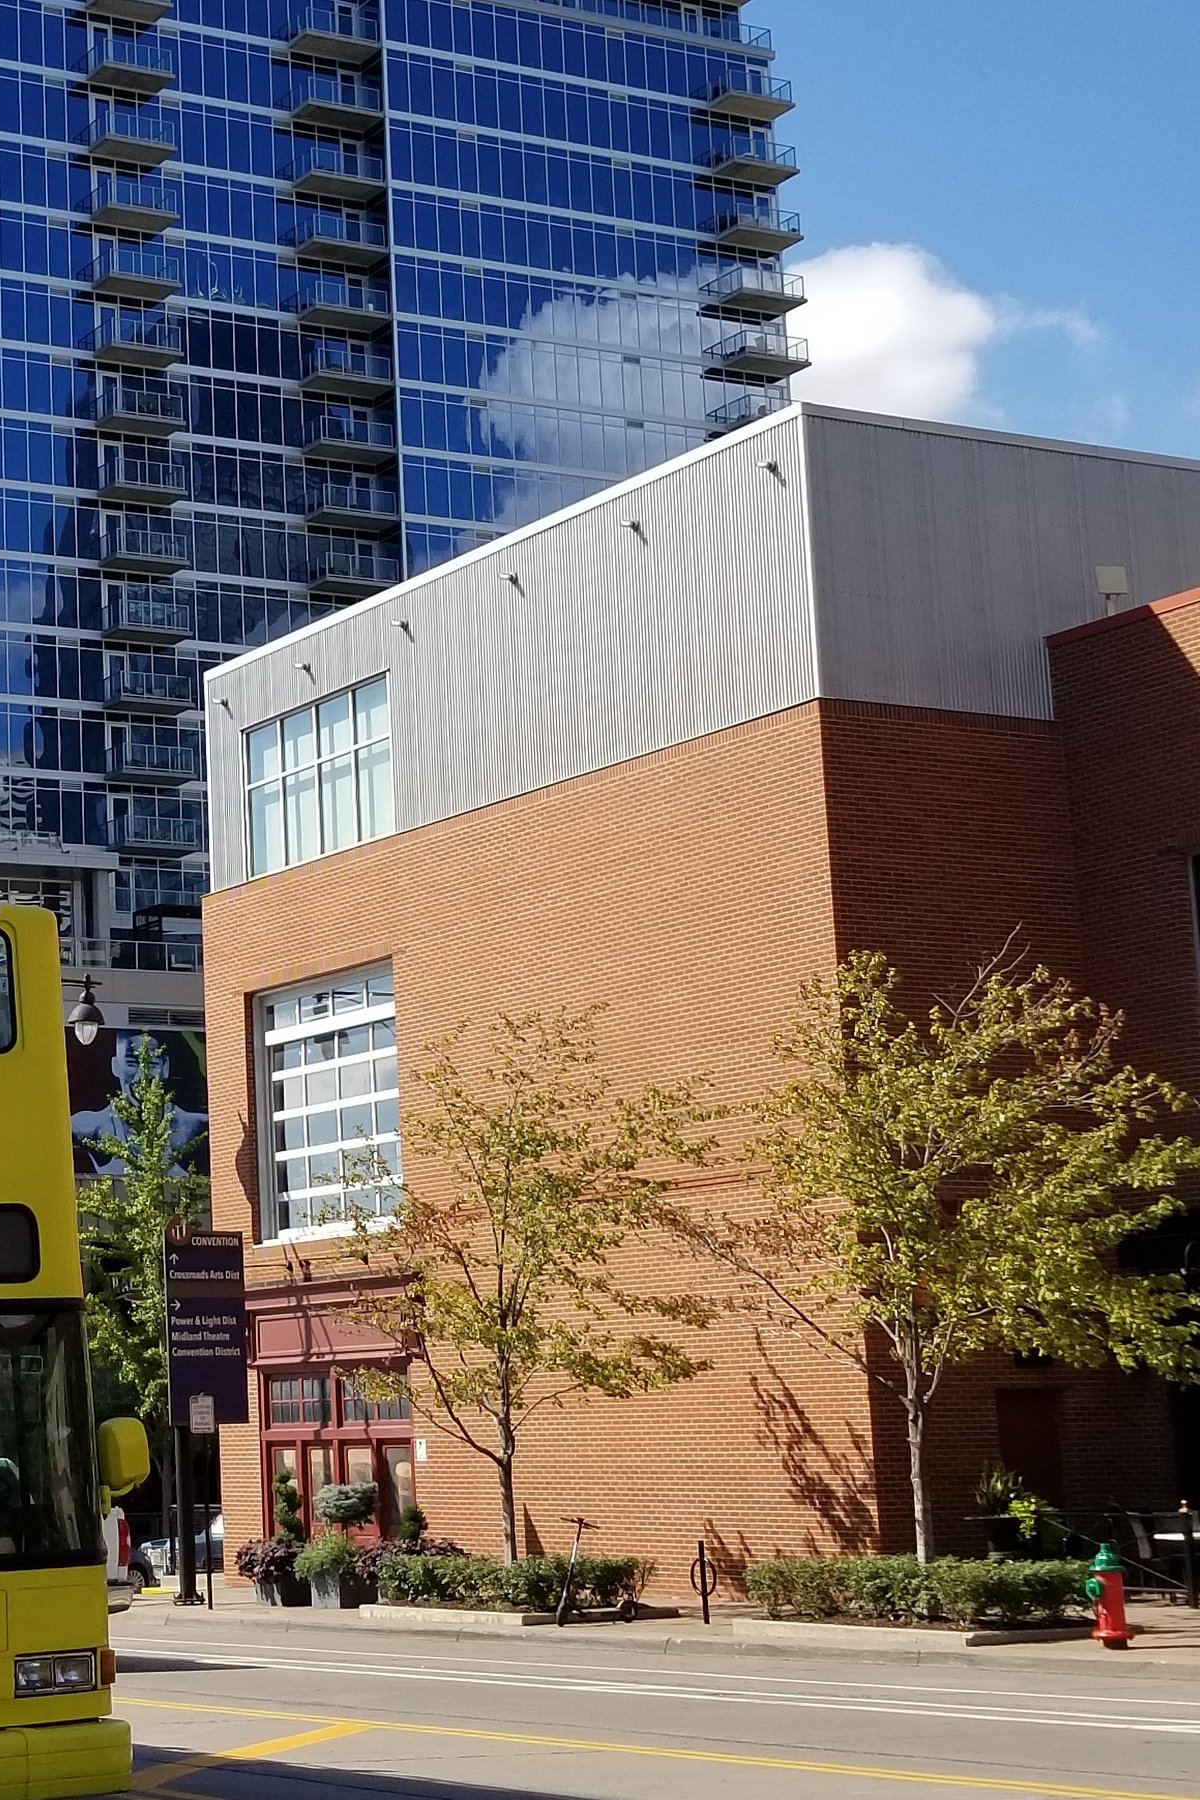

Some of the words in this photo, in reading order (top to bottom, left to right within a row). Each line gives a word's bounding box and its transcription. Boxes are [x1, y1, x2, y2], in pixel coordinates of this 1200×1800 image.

[191, 1236, 239, 1247] CONVENTION
[169, 1270, 209, 1280] Crossroads
[209, 1270, 224, 1280] Arts
[225, 1270, 240, 1280] Dist
[170, 1316, 194, 1326] Power
[194, 1316, 201, 1326] &
[201, 1316, 221, 1328] Light
[222, 1316, 237, 1326] Dist
[171, 1331, 202, 1341] Midland
[203, 1331, 230, 1341] Theatre
[172, 1347, 214, 1357] Convention
[214, 1347, 241, 1357] District
